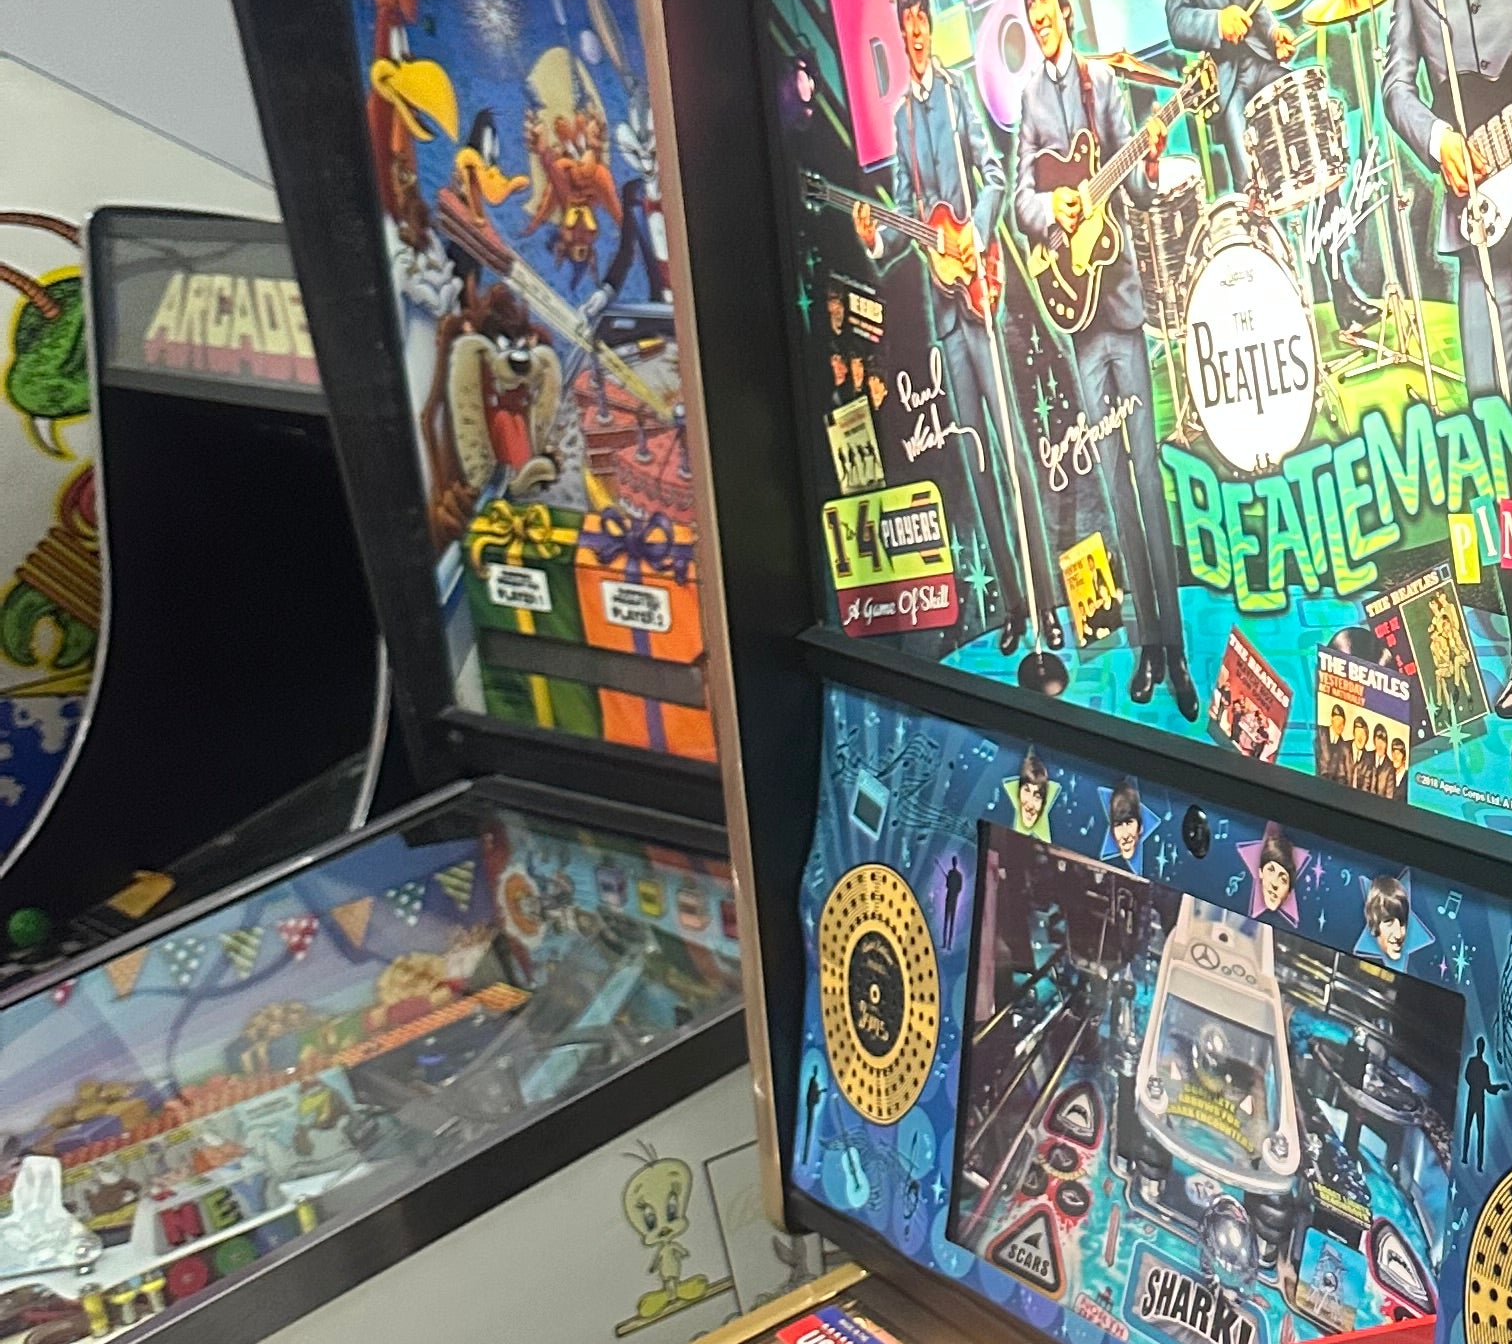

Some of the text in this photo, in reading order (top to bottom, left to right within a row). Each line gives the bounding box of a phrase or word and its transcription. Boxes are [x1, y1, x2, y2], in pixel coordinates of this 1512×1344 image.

[148, 272, 312, 386] ARCADE
[1232, 309, 1255, 332] THE
[1192, 321, 1309, 414] BEATLES
[825, 506, 851, 578] 1
[856, 502, 883, 572] 4
[882, 510, 940, 547] PLAYERS
[843, 584, 950, 626] A Game Of Skill
[1366, 571, 1440, 617] THE BEATLES
[1247, 652, 1290, 708] BEATLES
[1319, 652, 1410, 701] THE BEATLES
[1319, 670, 1365, 695] YESTERDAY
[1439, 780, 1461, 796] Apple
[1462, 786, 1485, 803] Corps
[1007, 1244, 1050, 1277] SCARS
